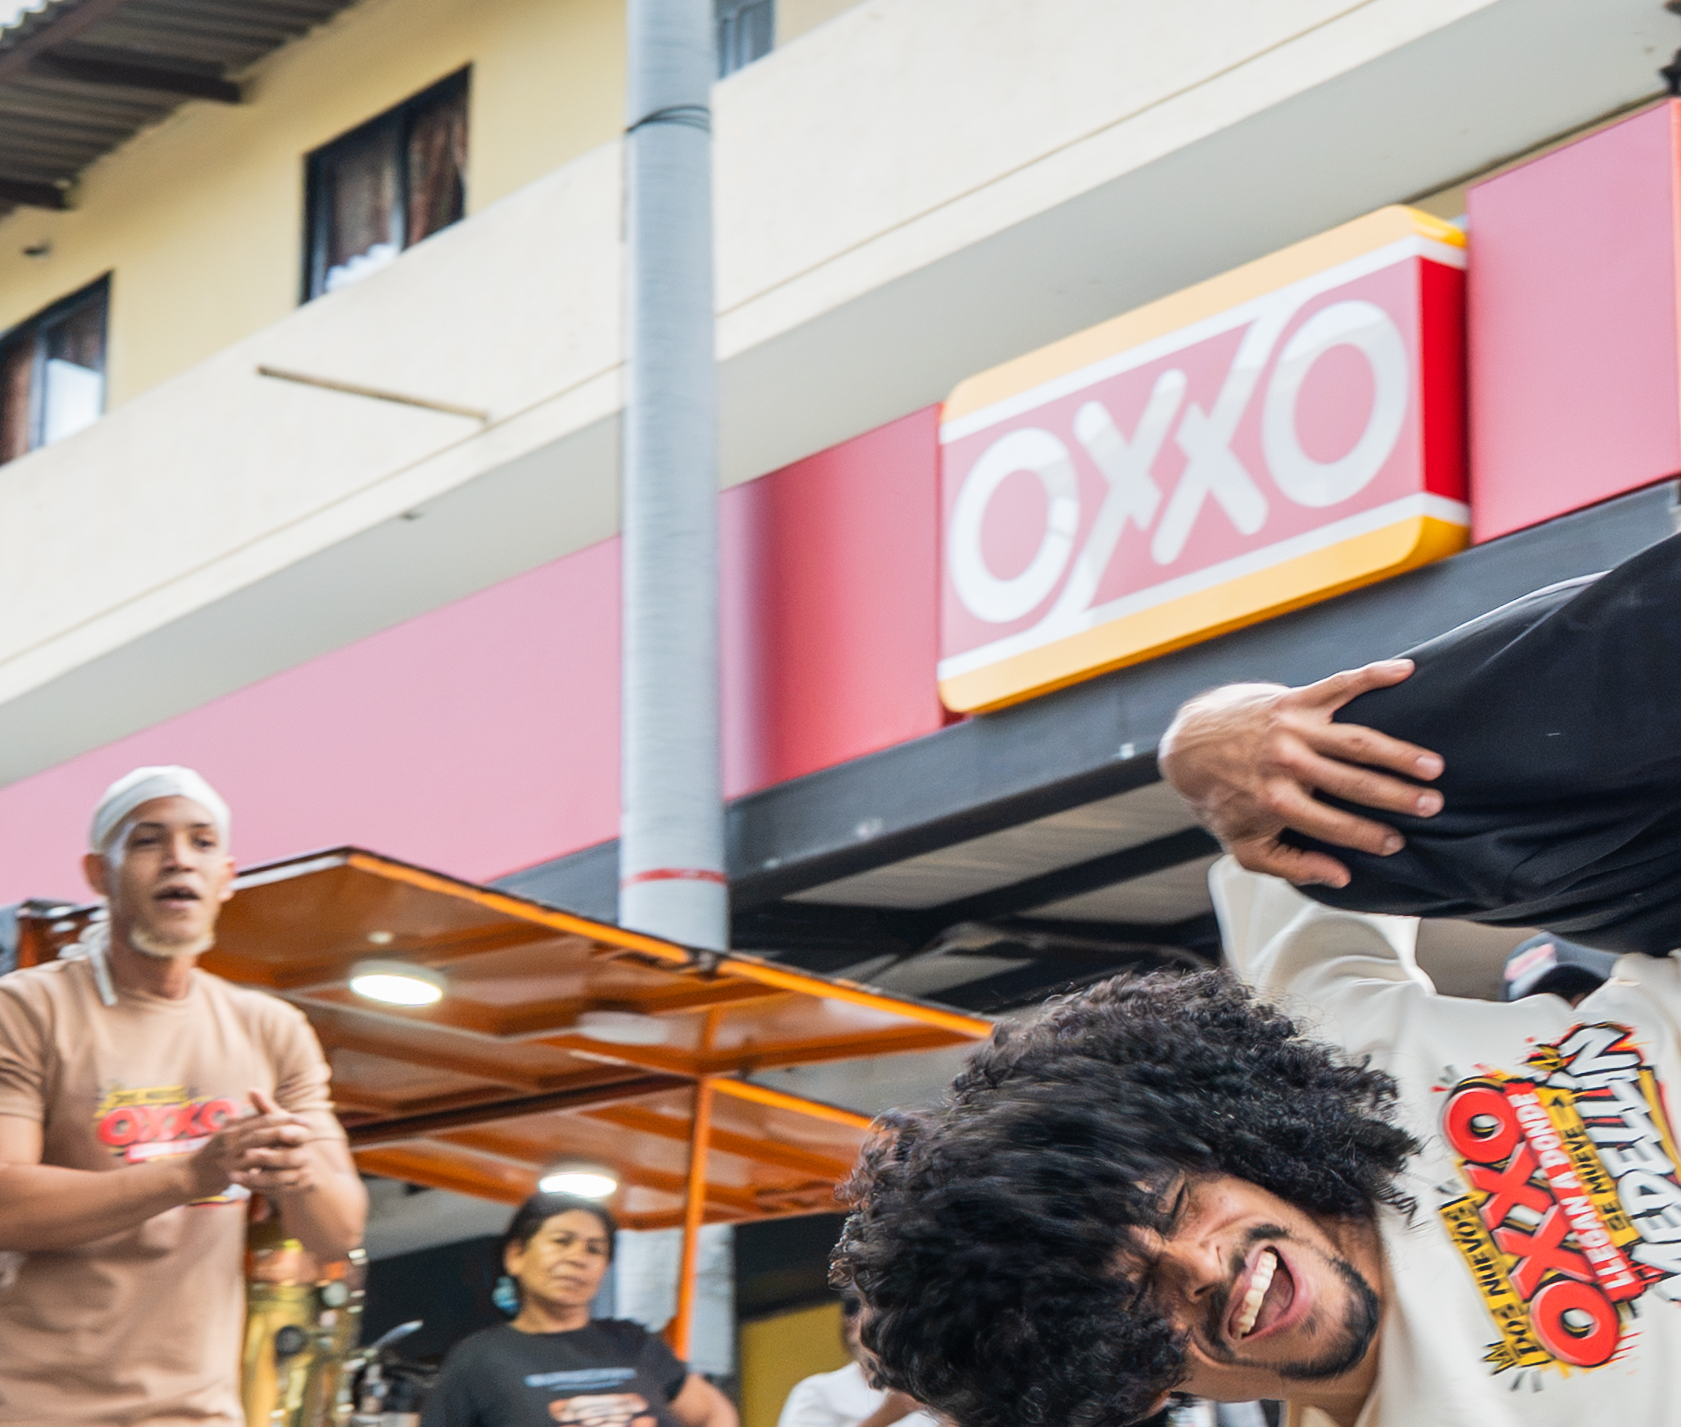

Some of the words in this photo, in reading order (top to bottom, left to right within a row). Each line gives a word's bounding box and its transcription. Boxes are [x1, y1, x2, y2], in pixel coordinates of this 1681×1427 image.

[947, 296, 1409, 629] OXXO
[1507, 1091, 1568, 1171] DONDE
[1560, 1125, 1611, 1197] MUEVE
[1548, 1168, 1582, 1188] A
[1442, 1087, 1620, 1367] OXXO
[1443, 1204, 1509, 1300] NUEVOS
[1560, 1195, 1634, 1292] LLEGAN
[1496, 1305, 1539, 1357] DOS
